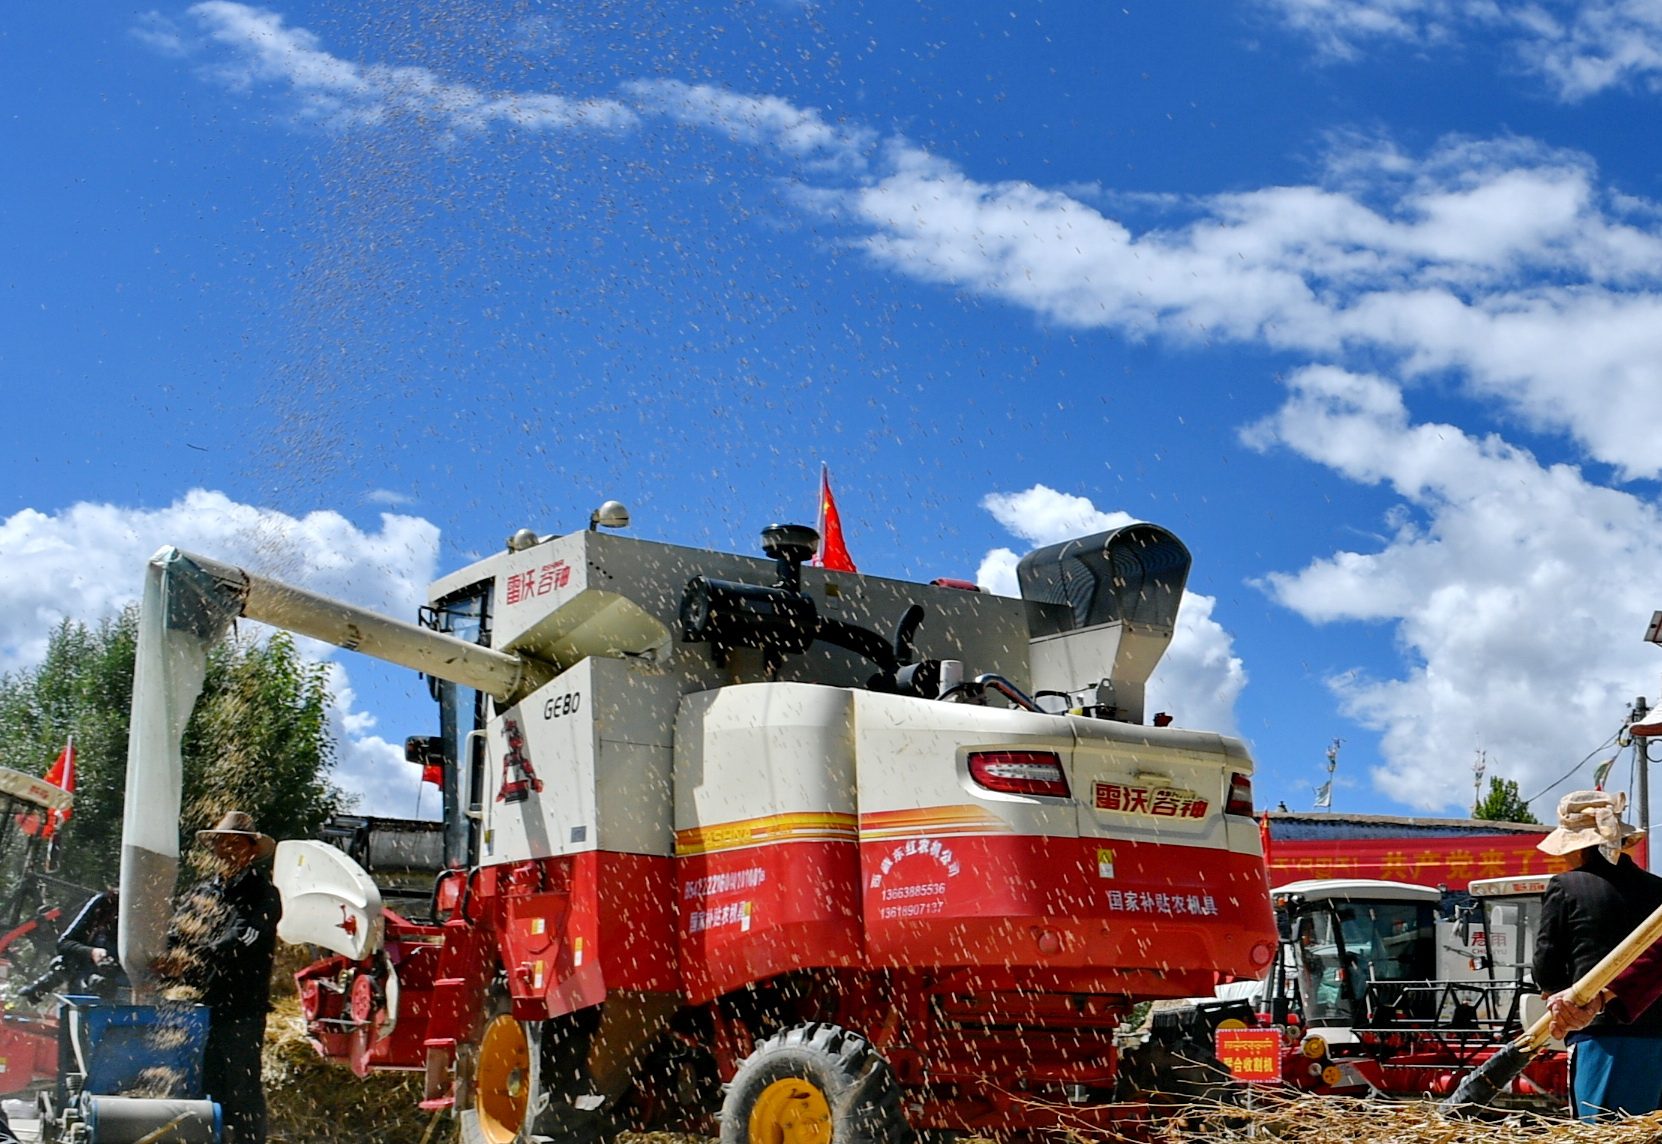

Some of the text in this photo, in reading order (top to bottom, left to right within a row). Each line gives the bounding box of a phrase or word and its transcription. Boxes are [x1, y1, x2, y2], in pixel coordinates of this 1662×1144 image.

[506, 565, 572, 605] 雷沃谷神
[544, 691, 581, 720] GE80
[1096, 783, 1209, 818] 雷沃谷神
[1107, 890, 1218, 916] 国家补贴农机具
